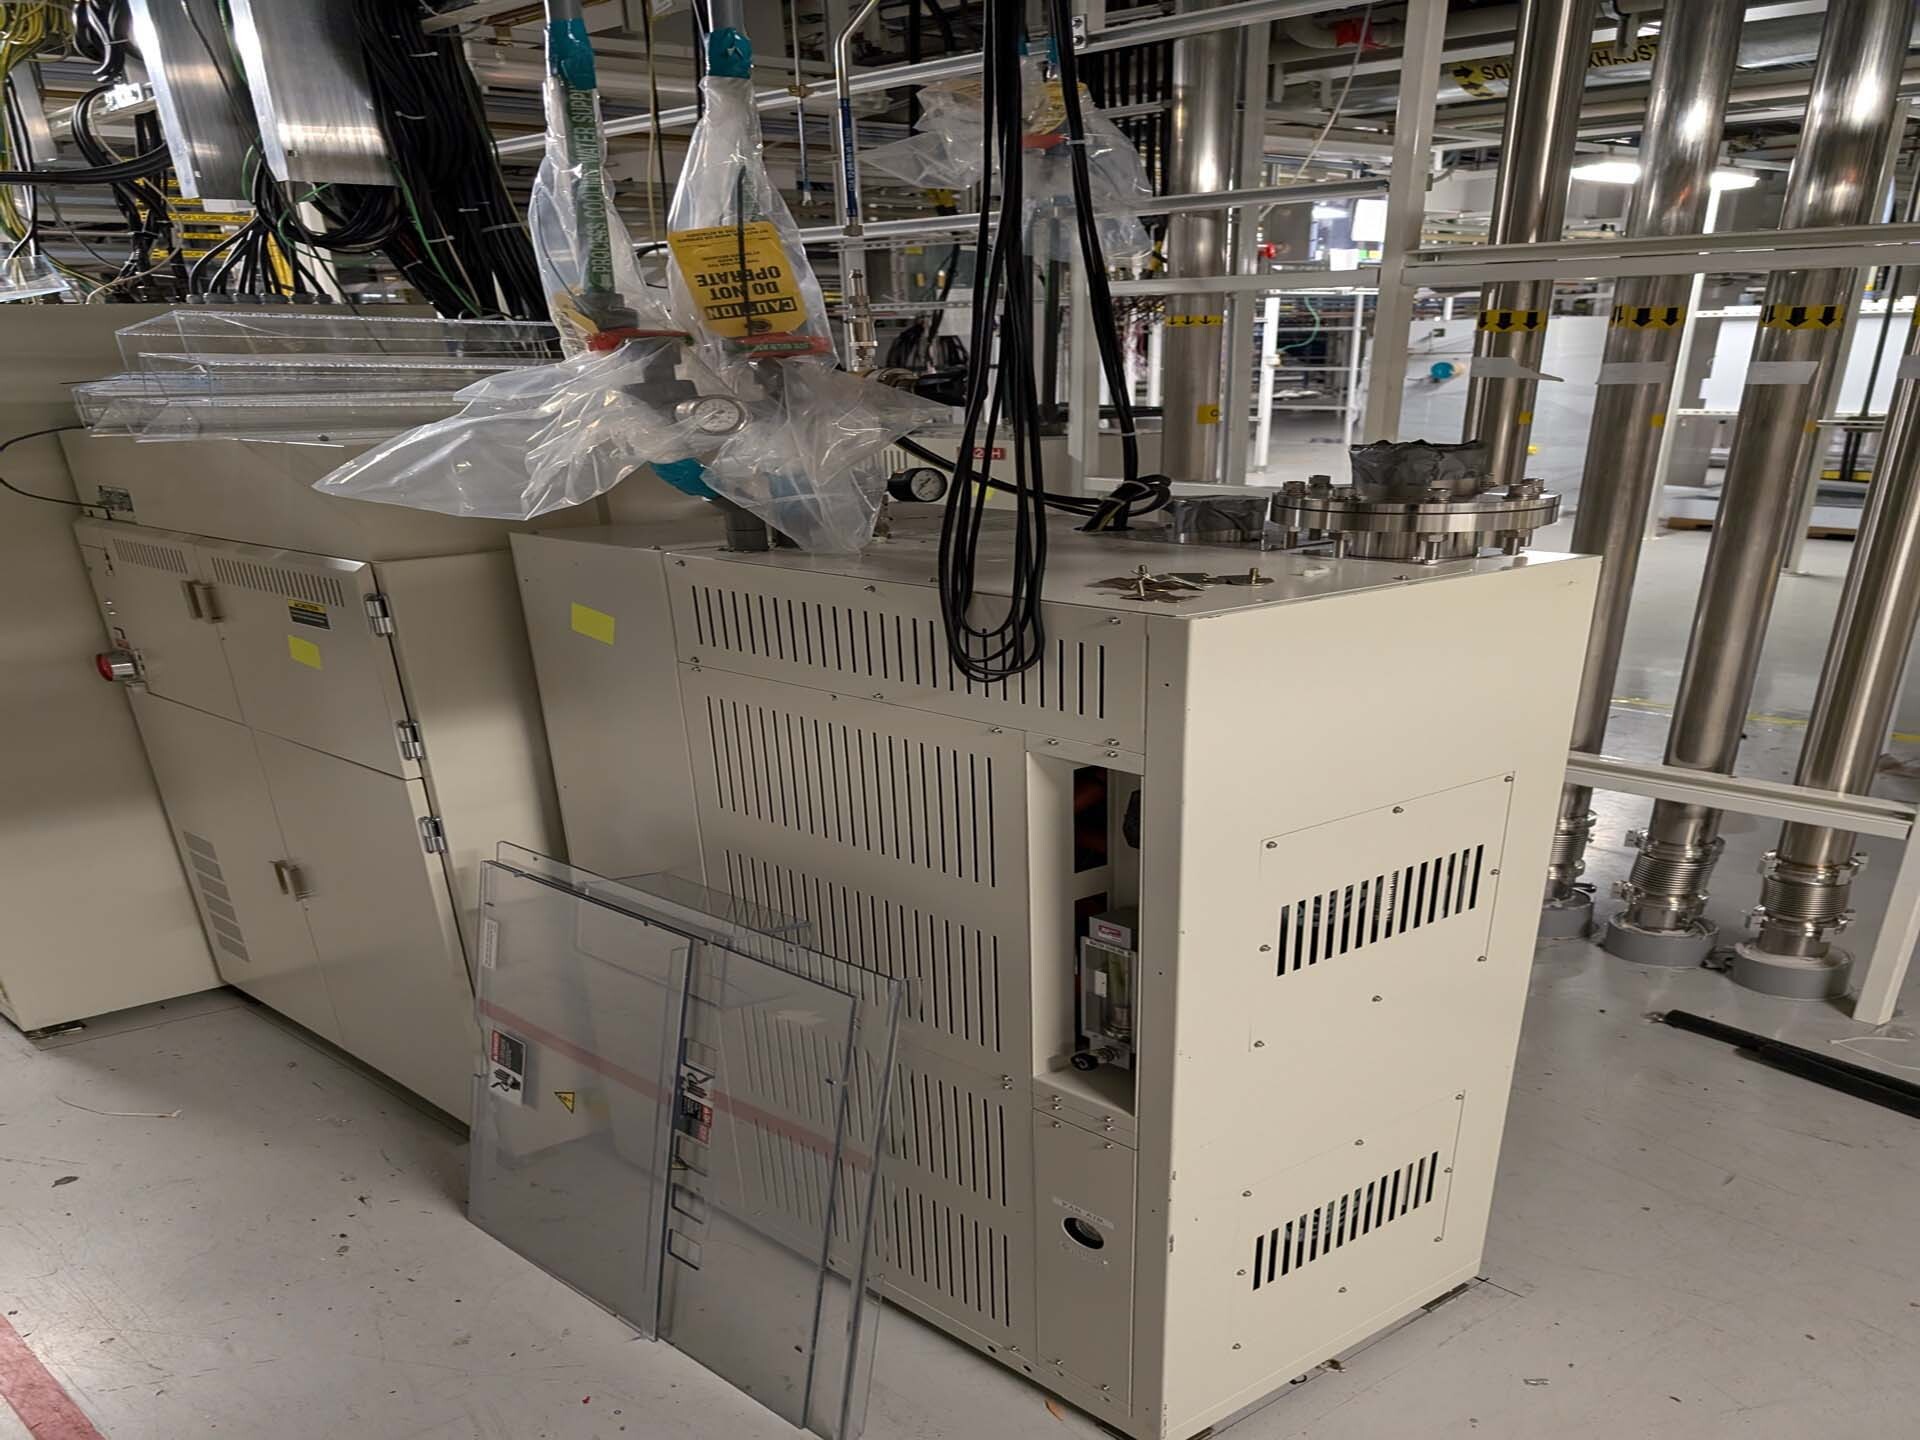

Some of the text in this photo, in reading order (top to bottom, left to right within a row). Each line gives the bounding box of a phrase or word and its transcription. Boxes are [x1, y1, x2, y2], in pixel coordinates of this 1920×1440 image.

[569, 85, 594, 124] SUPPL
[574, 126, 600, 163] WATER
[586, 222, 611, 273] PROCESS
[694, 266, 782, 287] OPERATE
[708, 281, 779, 301] DO NOT
[706, 298, 795, 319] CAUION
